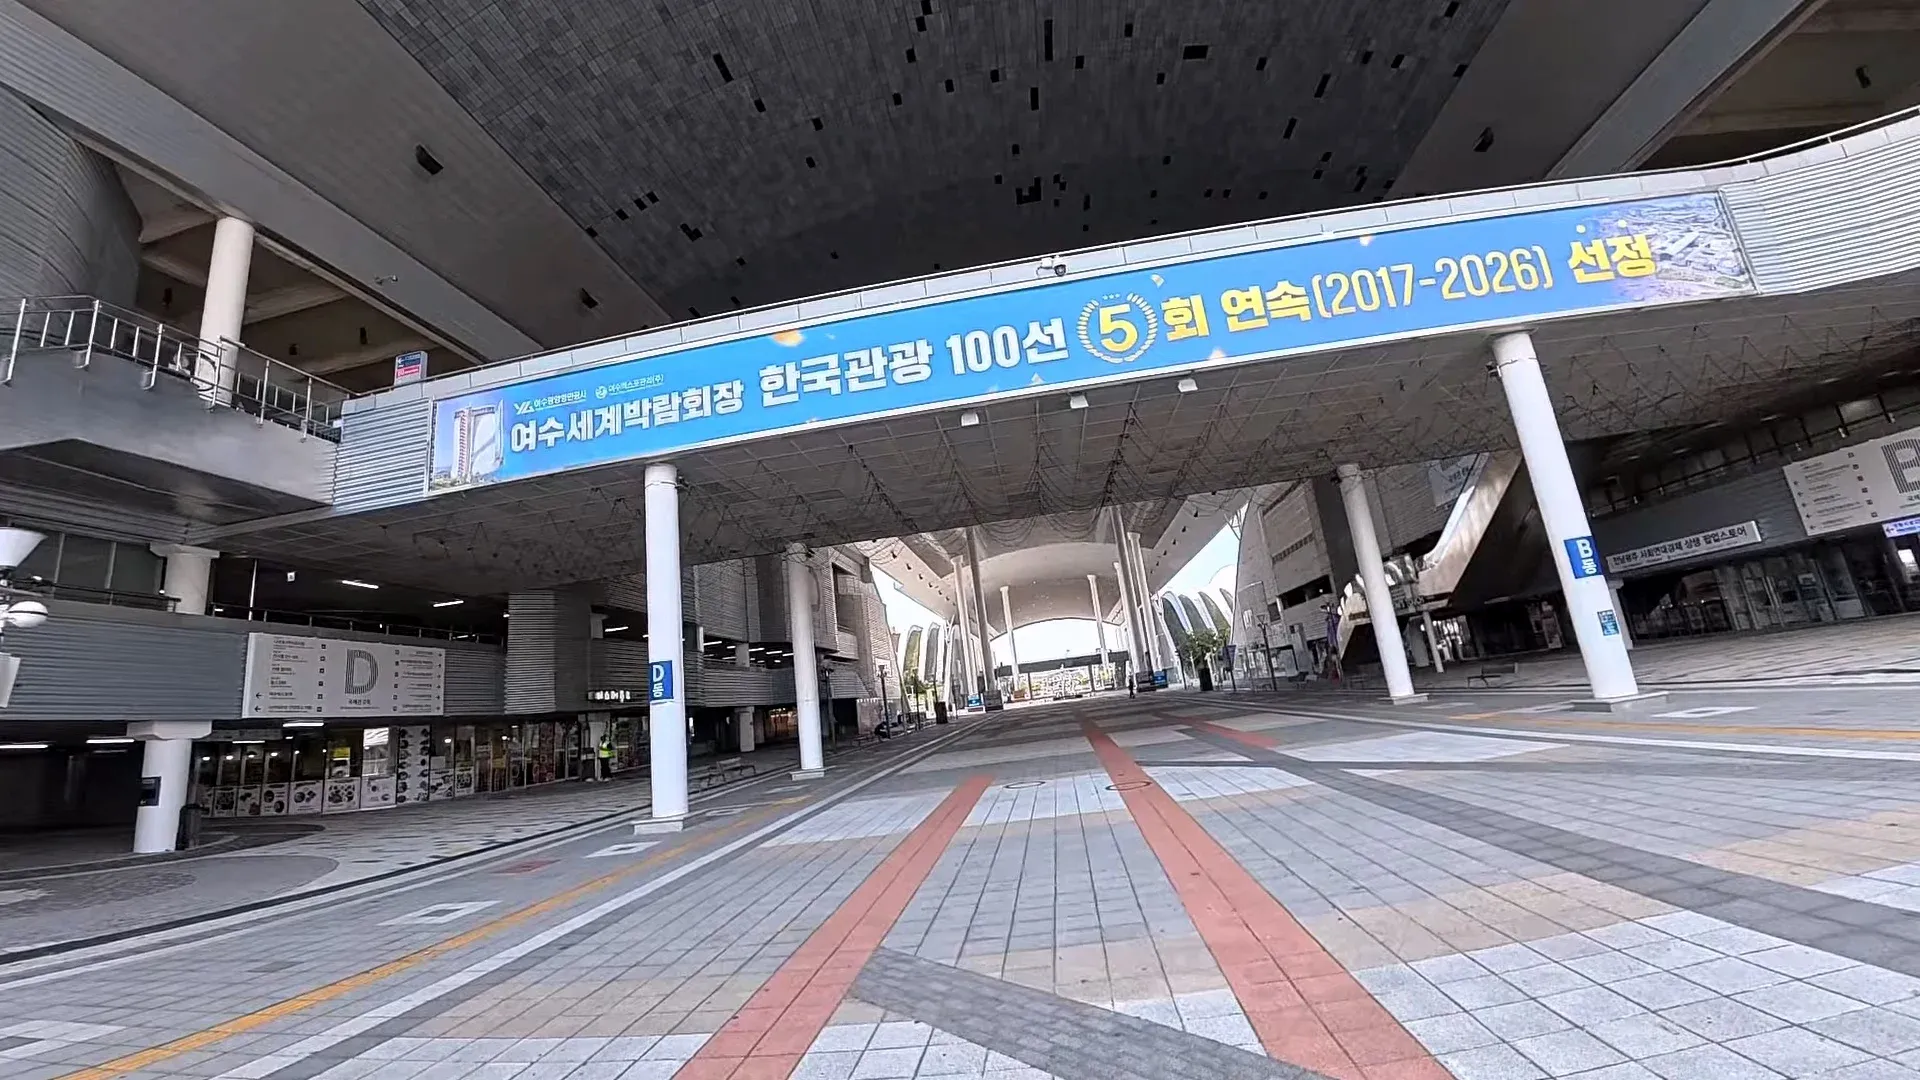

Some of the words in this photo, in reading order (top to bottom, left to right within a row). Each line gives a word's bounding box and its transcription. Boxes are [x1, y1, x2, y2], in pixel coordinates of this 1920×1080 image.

[511, 380, 744, 453] 여수세계박람회장
[759, 339, 934, 408] 한국관광
[946, 316, 1069, 375] 100선
[1099, 303, 1138, 352] 5
[1161, 294, 1210, 342] 회
[1220, 245, 1553, 333] 연속(2017-2026)
[1568, 234, 1657, 284] 선정
[1702, 526, 1747, 545] 팝업스토어
[345, 649, 379, 694] D
